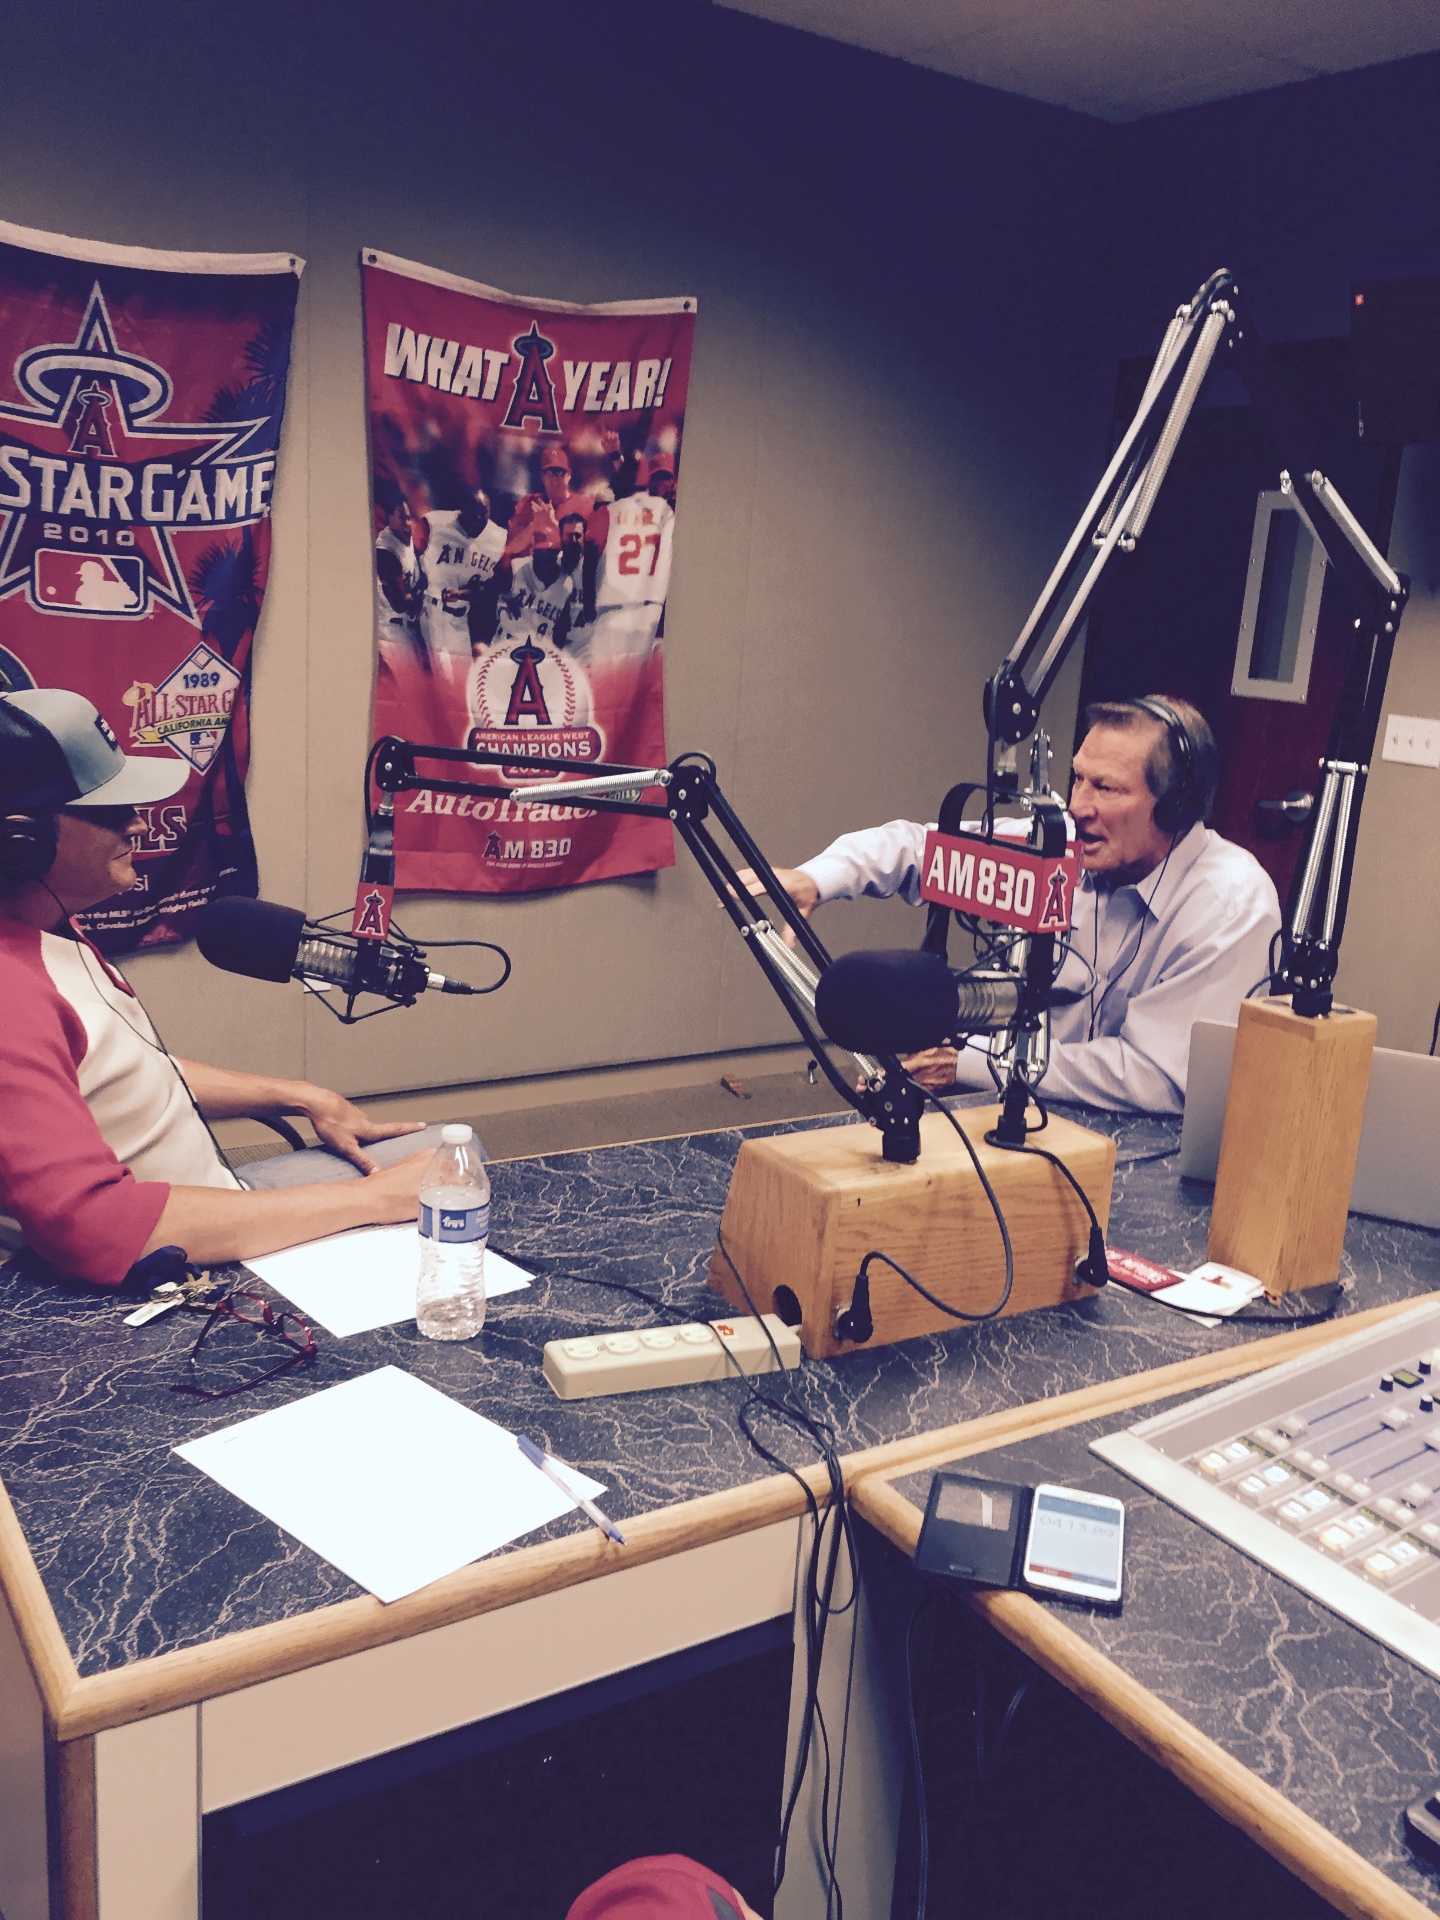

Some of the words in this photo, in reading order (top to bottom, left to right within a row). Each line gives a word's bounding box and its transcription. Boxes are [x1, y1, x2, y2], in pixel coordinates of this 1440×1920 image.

[384, 322, 509, 401] WHAT
[563, 358, 672, 412] YEAR!
[141, 460, 275, 522] GAME
[43, 523, 135, 546] 2010
[618, 533, 661, 576] 27
[183, 672, 220, 689] 1989
[157, 718, 212, 734] CALIFORNIA
[475, 732, 519, 741] AMERICAN
[521, 733, 560, 741] LEAGUE
[562, 731, 590, 740] WEST
[476, 741, 591, 758] CHAMPIONS
[530, 838, 571, 859] 830
[926, 845, 1036, 917] AM830
